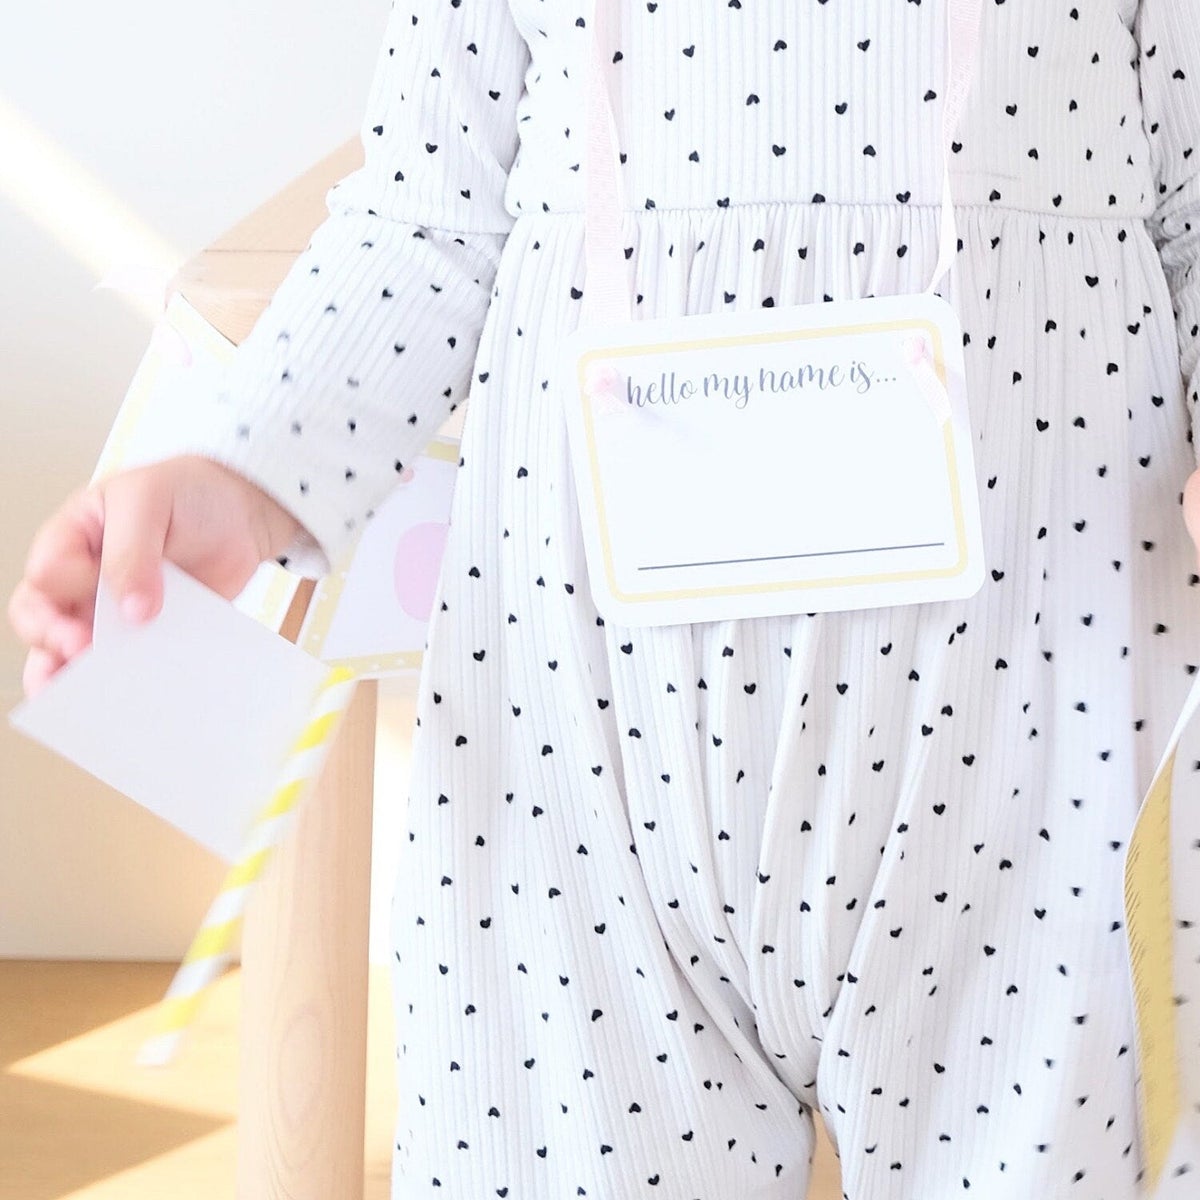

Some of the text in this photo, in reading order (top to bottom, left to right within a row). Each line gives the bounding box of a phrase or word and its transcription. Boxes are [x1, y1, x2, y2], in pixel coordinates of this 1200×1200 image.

[626, 360, 897, 409] hello my name is...
